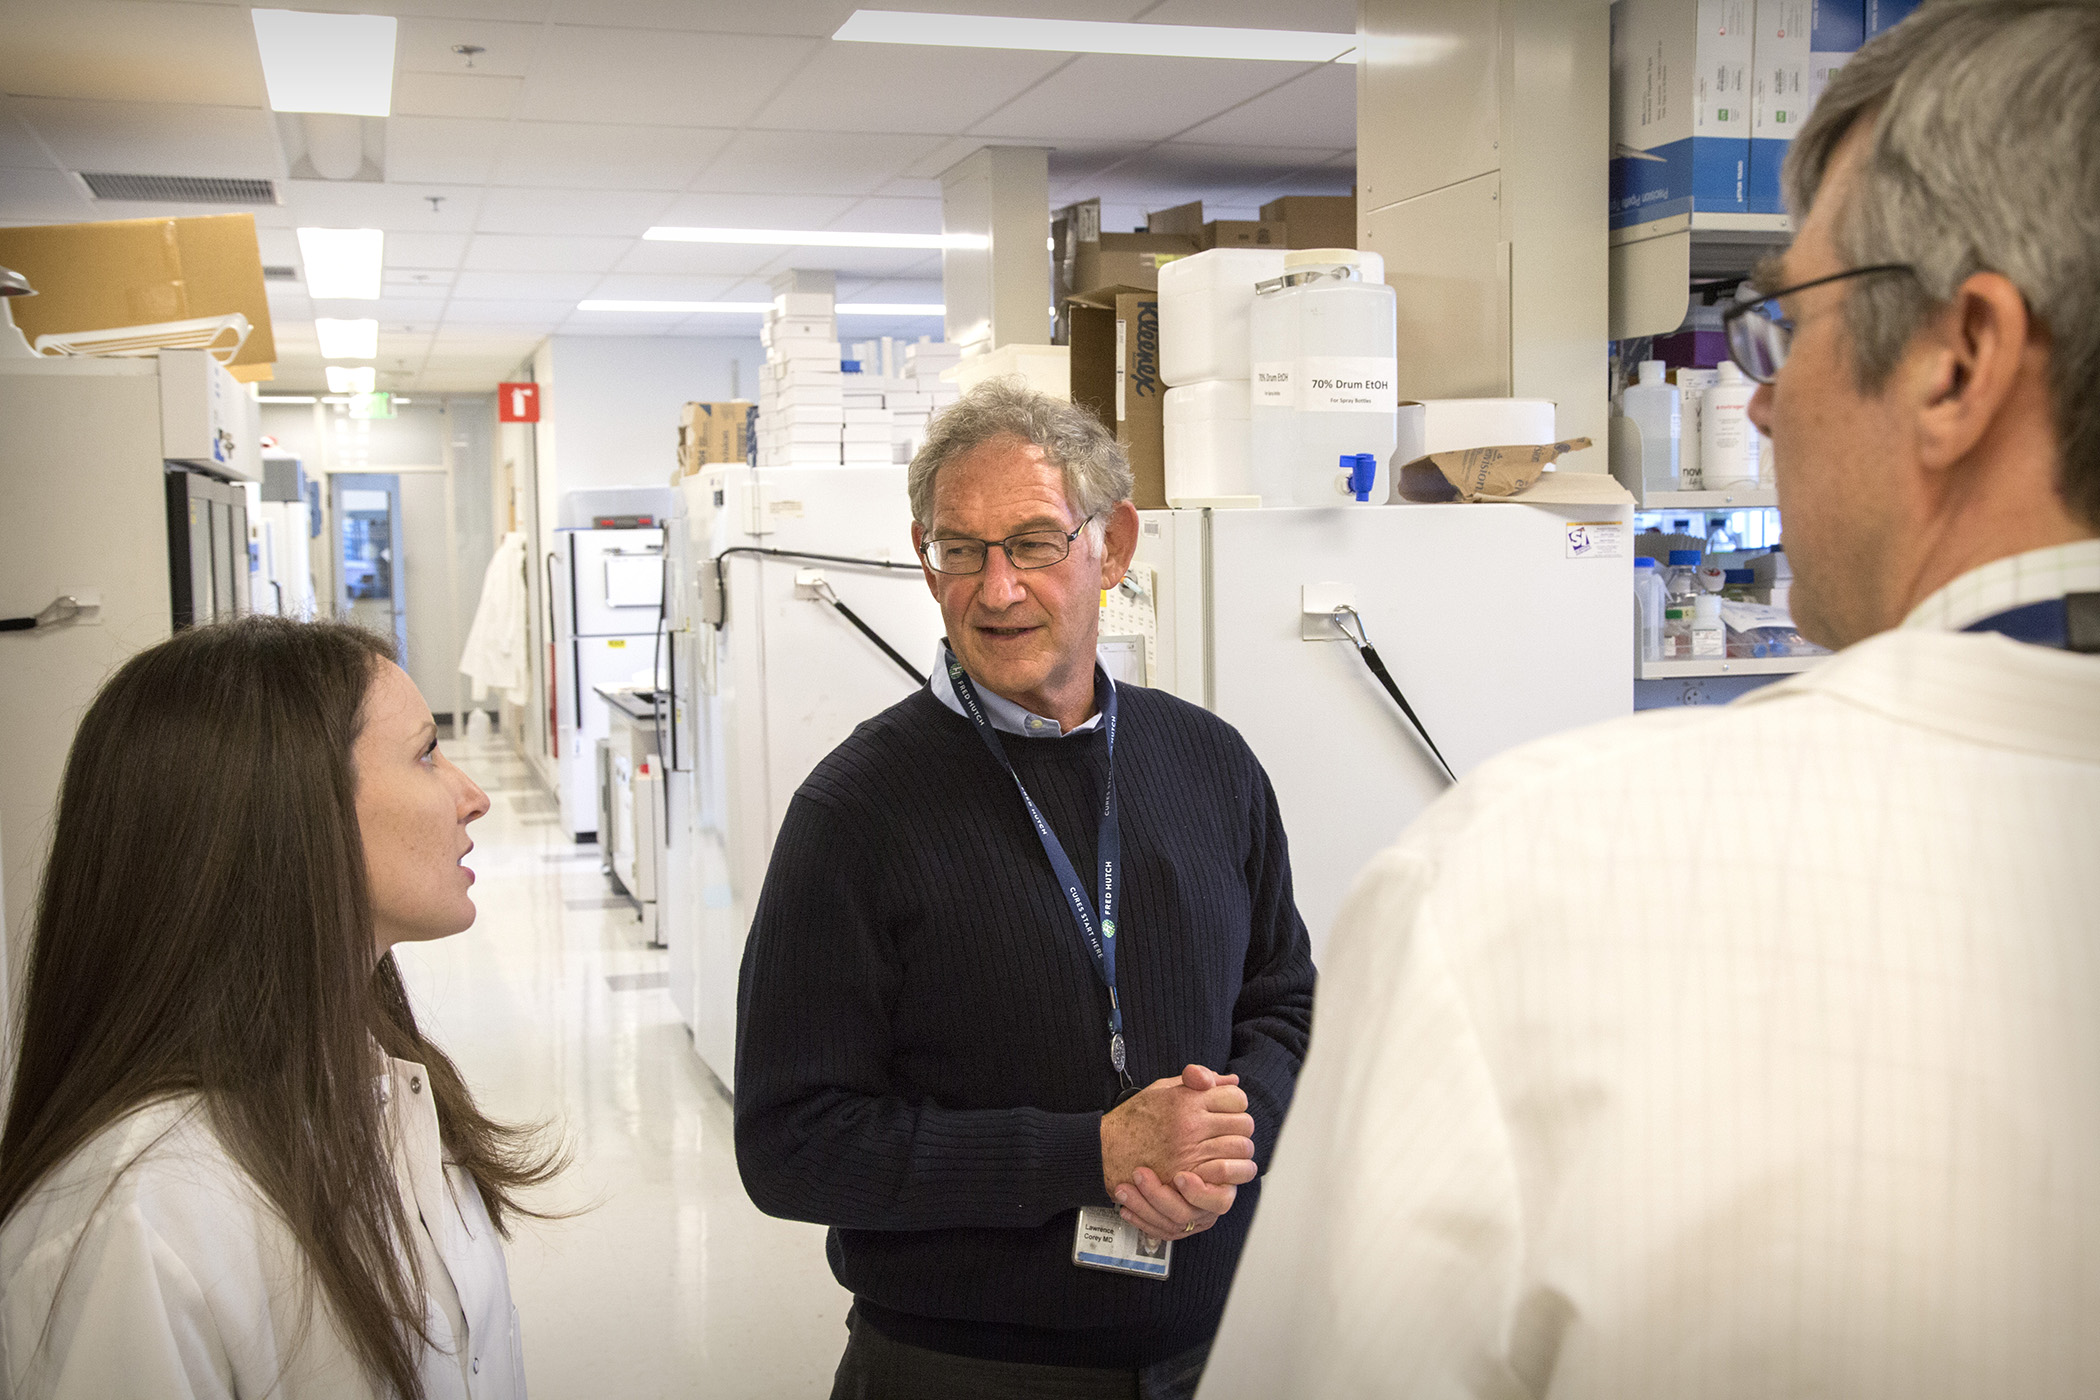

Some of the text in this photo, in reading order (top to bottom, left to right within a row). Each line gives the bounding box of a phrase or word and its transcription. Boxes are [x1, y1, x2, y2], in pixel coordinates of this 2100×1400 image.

[1311, 379, 1389, 390] 70% Drum EtOH
[957, 680, 985, 726] FRED HUTCH
[1104, 861, 1113, 916] FRED HUTCH
[1069, 886, 1104, 959] CURES START HERE
[1084, 1232, 1102, 1243] Corey
